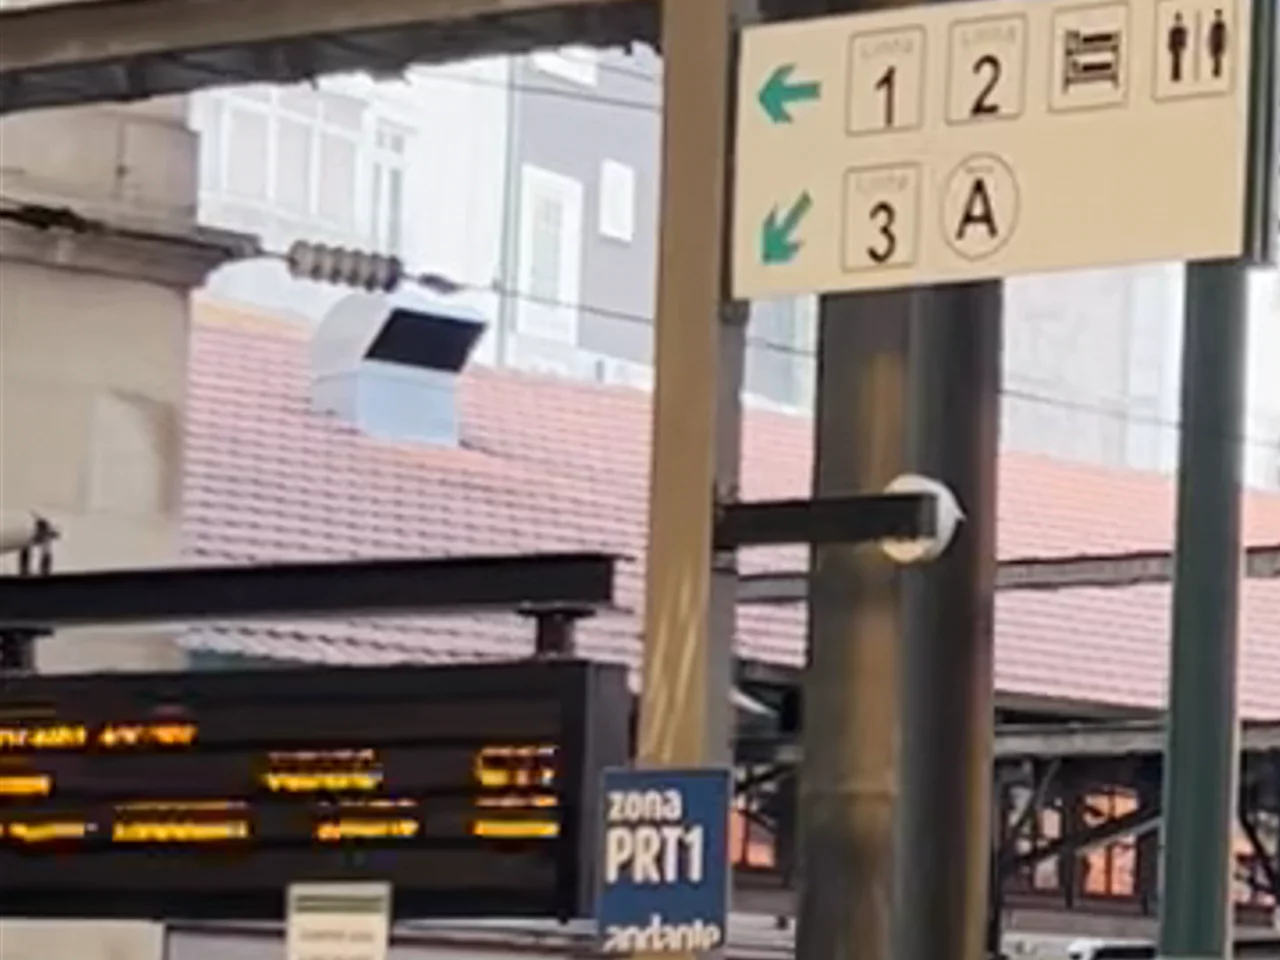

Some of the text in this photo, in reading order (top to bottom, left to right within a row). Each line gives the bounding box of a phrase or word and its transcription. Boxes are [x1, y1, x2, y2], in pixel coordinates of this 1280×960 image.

[874, 54, 1002, 127] 1 2
[866, 176, 998, 264] 3 A
[607, 788, 683, 822] zona
[605, 825, 704, 884] PRT1
[602, 912, 722, 953] andante
